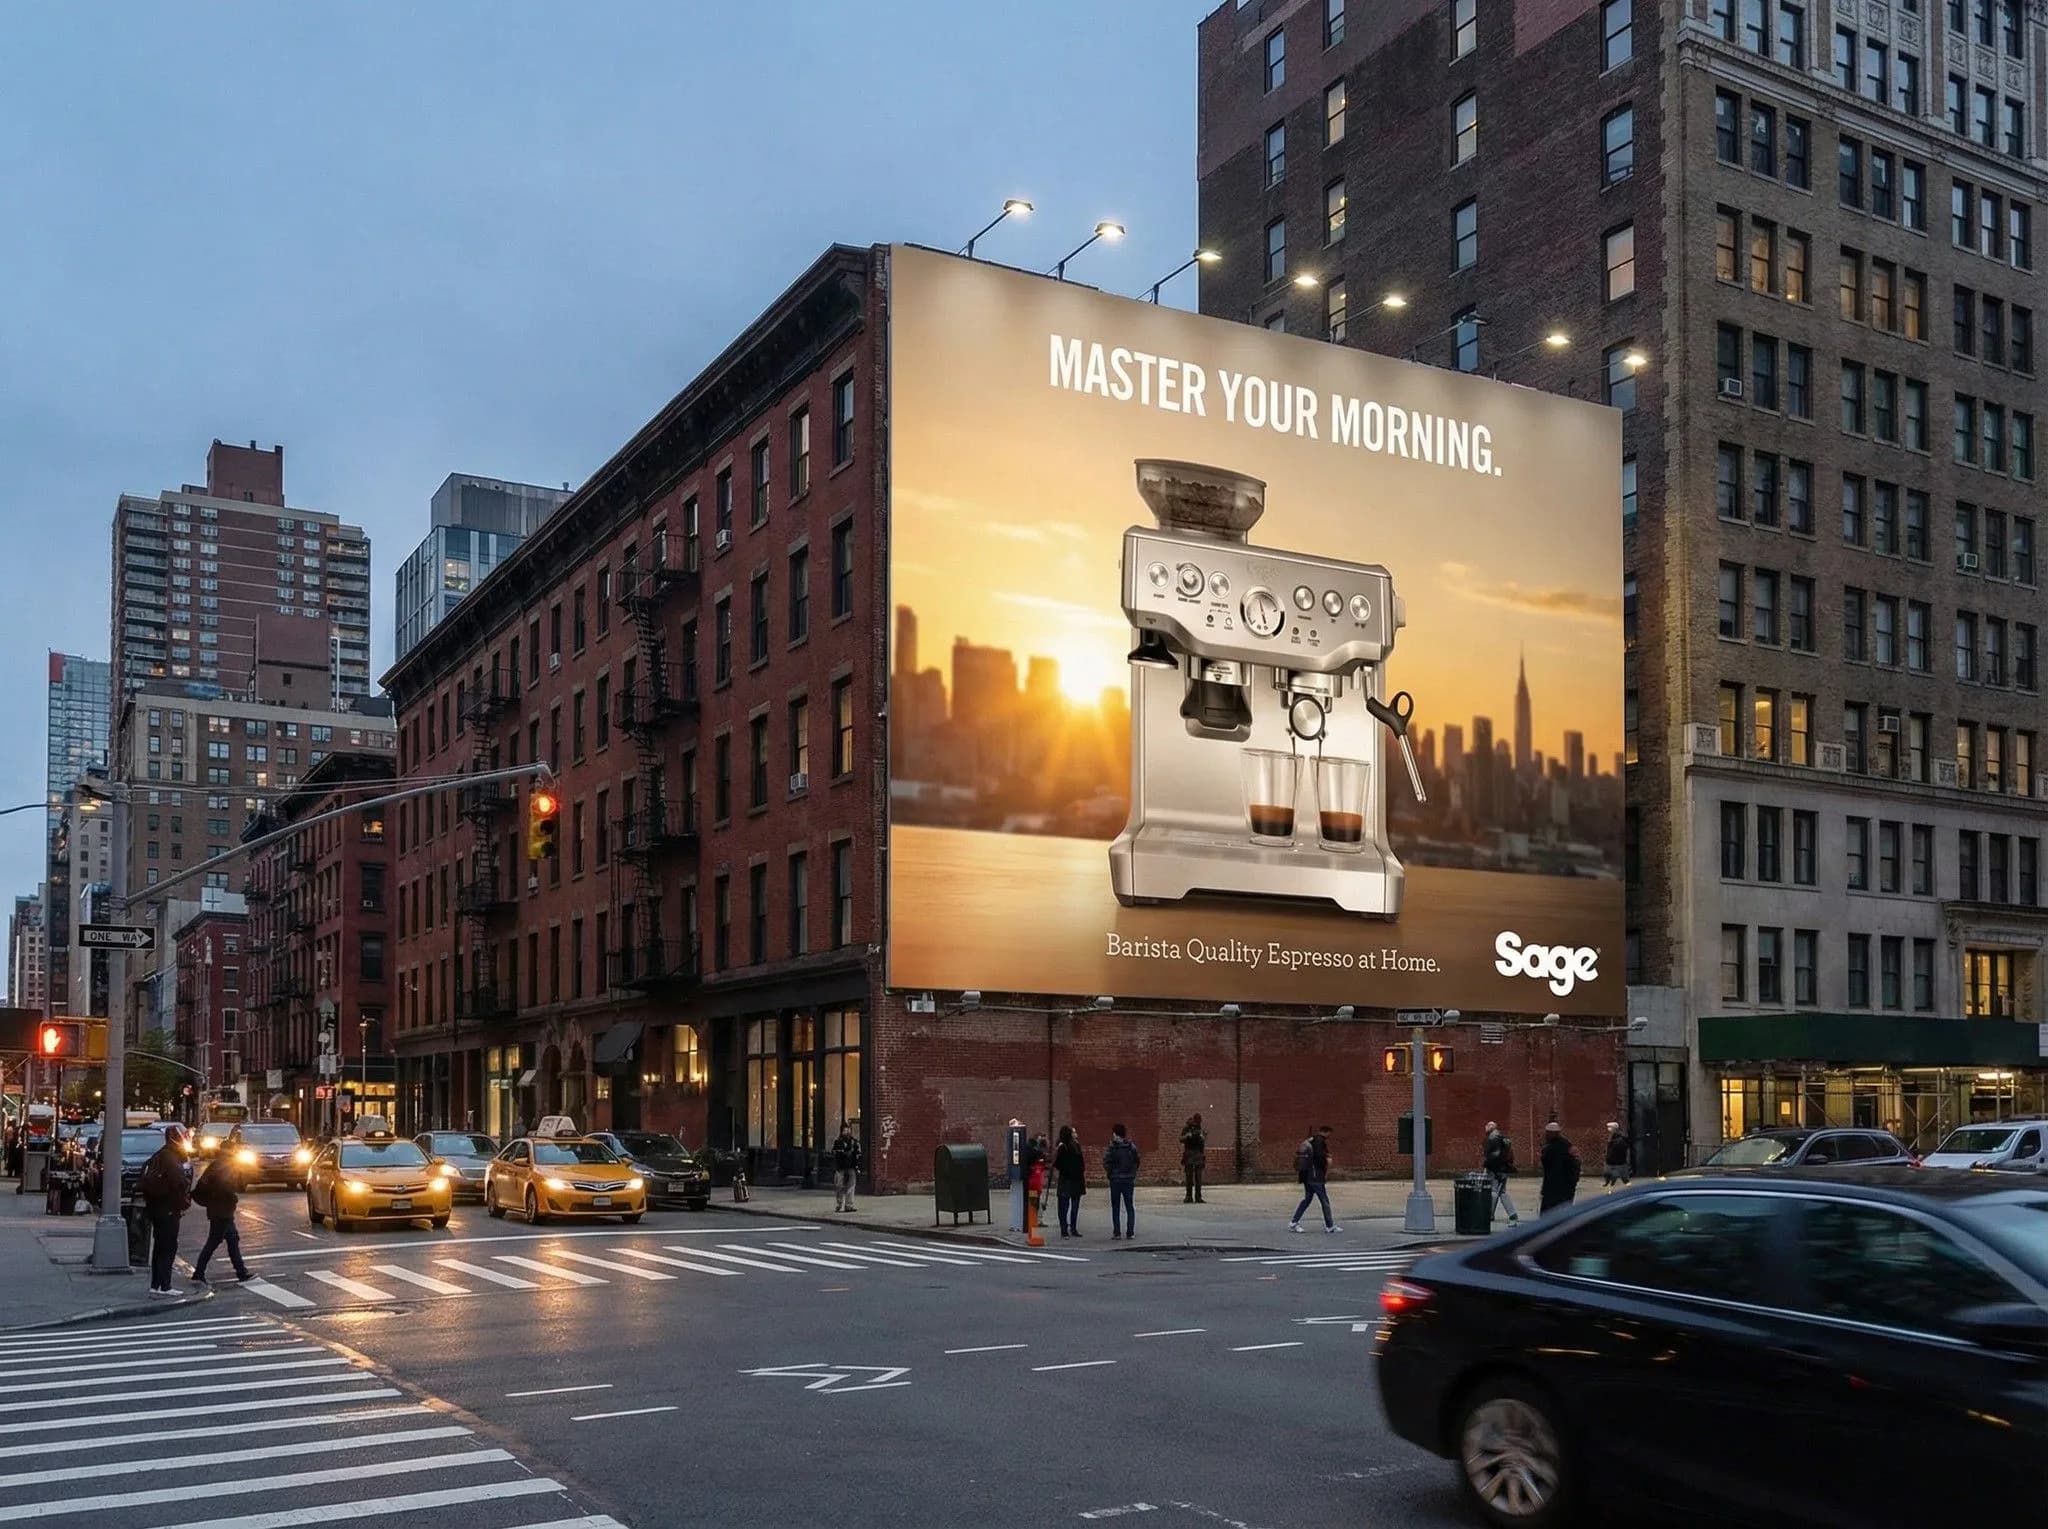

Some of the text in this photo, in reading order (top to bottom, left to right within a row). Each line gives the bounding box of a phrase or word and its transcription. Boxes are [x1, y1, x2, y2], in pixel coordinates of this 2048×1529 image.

[1050, 334, 1502, 476] MASTER YOUR MORNING.
[90, 931, 144, 943] ONE WAY
[1105, 933, 1442, 973] Barista Quality Espresso at Home.
[1494, 931, 1600, 997] Sage
